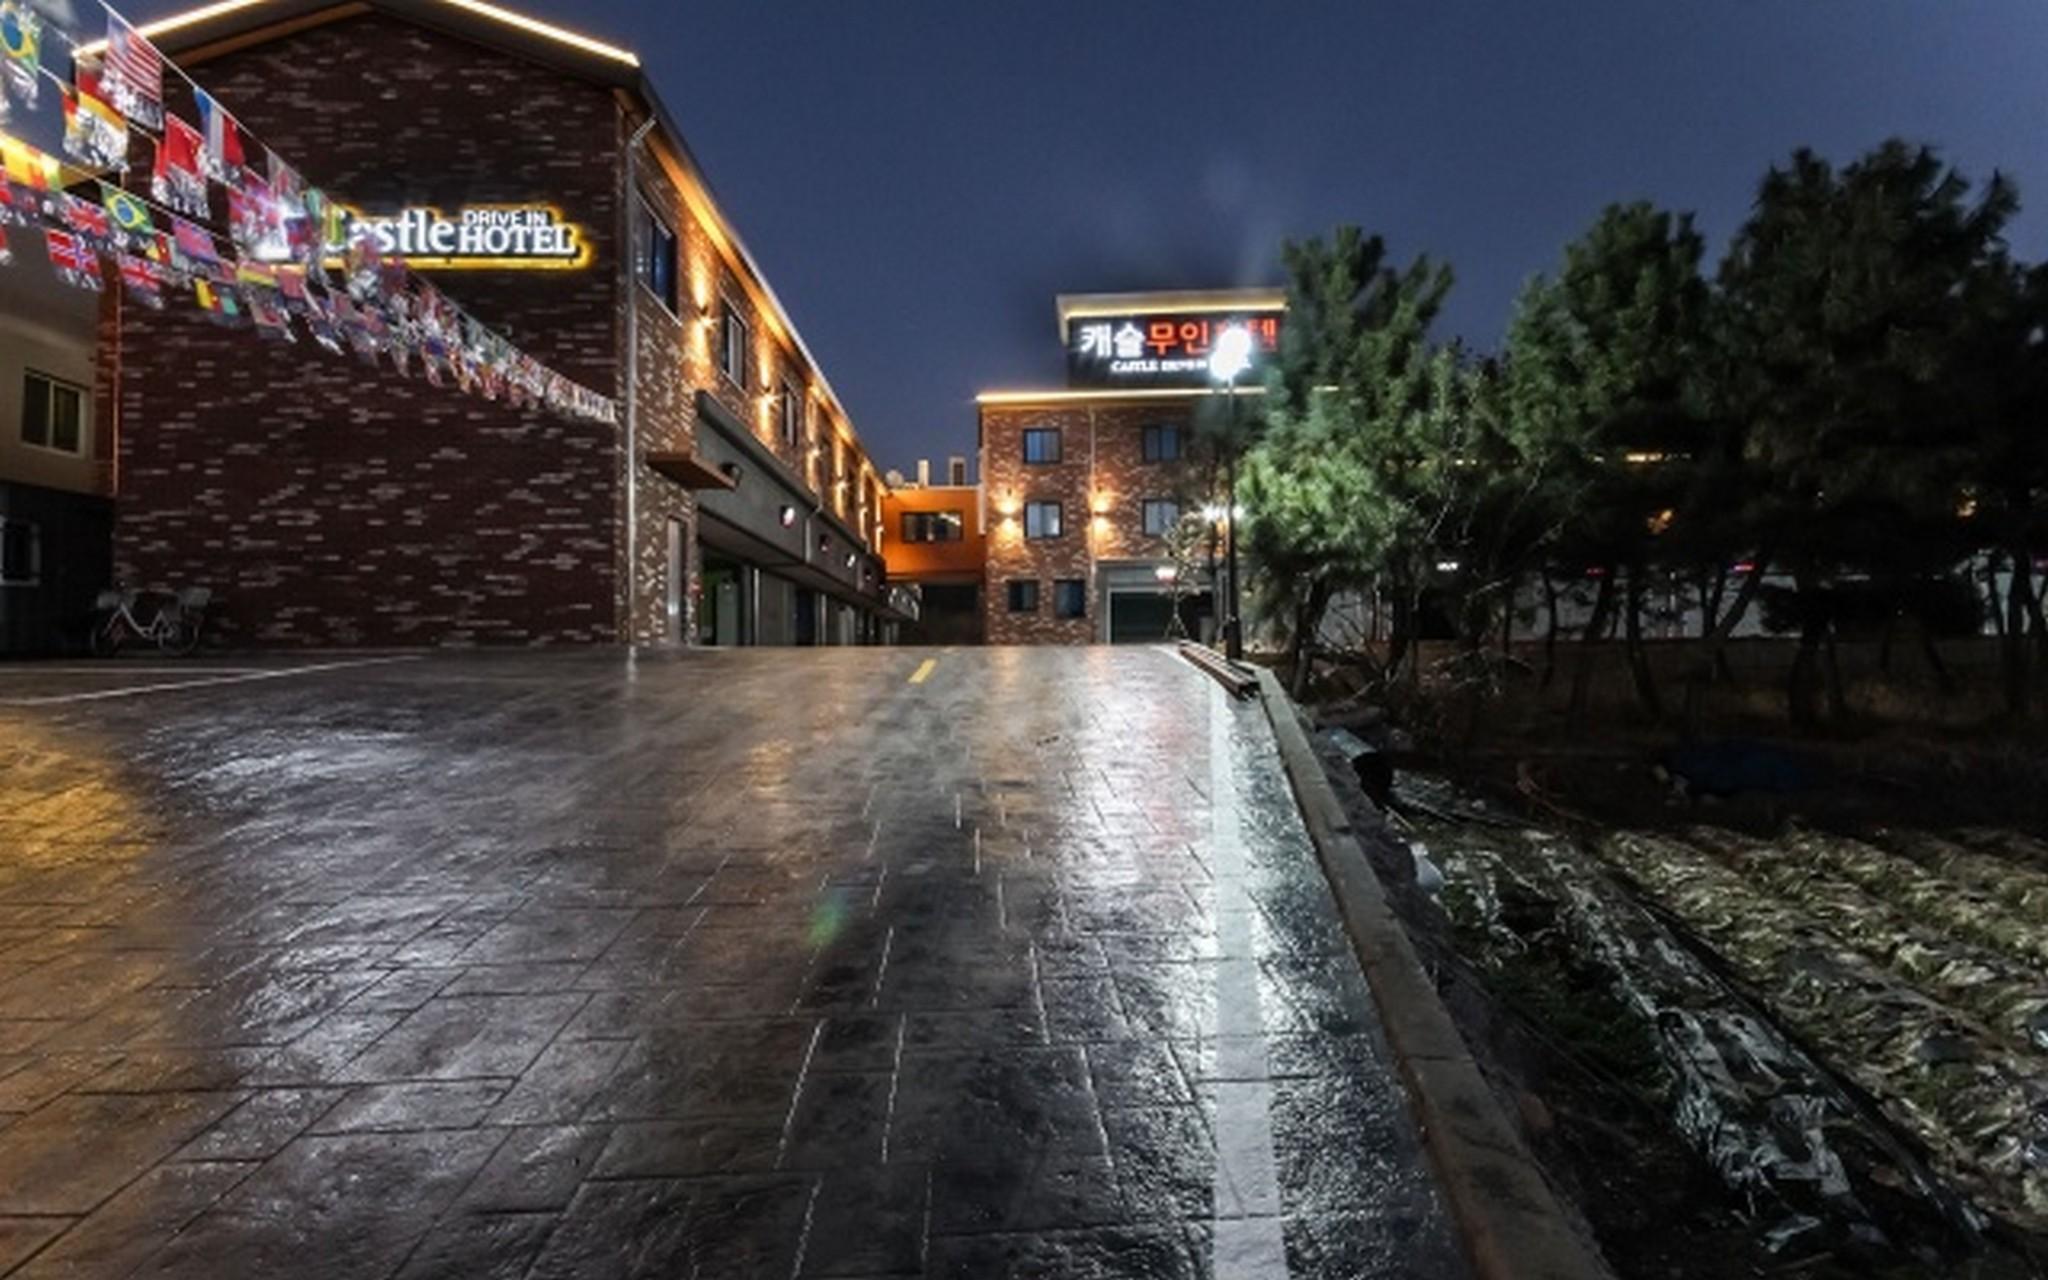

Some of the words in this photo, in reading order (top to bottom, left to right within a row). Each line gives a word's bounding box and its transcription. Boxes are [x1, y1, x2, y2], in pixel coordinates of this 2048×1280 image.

[462, 209, 524, 226] DRIVE
[525, 209, 548, 226] IN
[457, 224, 577, 254] HOTEL
